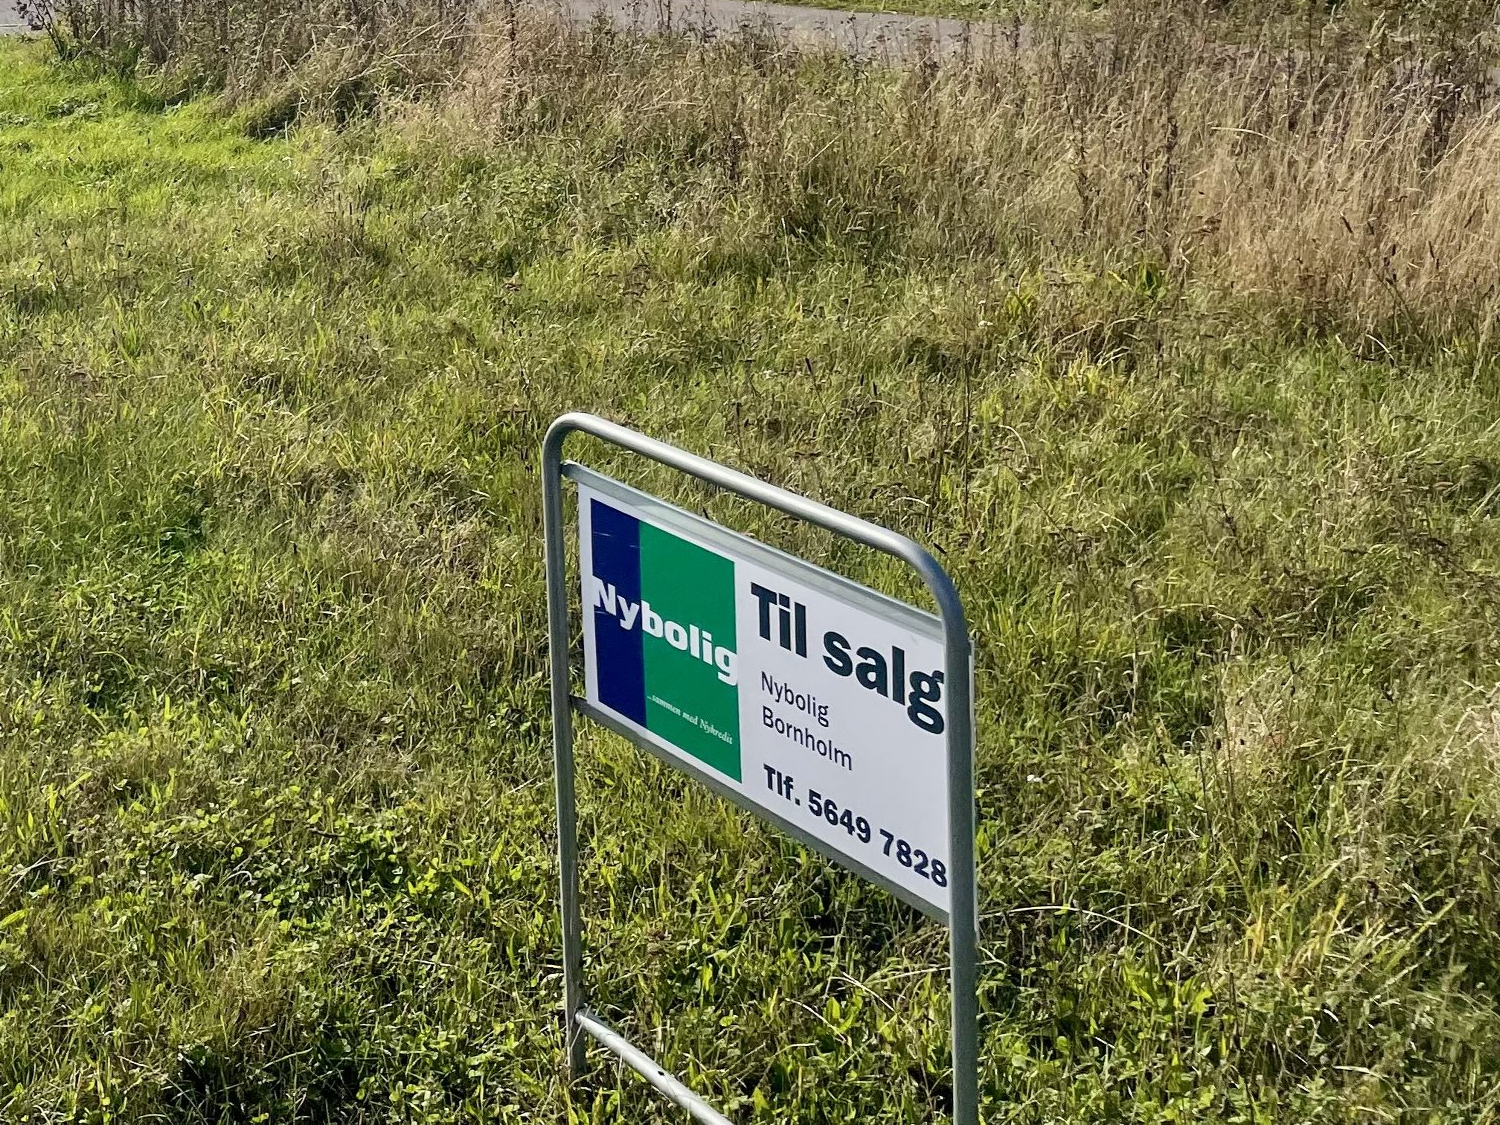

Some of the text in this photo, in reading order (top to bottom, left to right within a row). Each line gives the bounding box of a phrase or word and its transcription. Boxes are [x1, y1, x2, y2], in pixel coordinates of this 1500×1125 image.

[593, 575, 738, 686] Nybolig
[750, 581, 945, 735] Til salg
[700, 718, 733, 745] Nykredit
[761, 671, 829, 728] Nybolig
[762, 705, 853, 771] Bornholm
[763, 763, 948, 888] Tlf. 5649 7828
